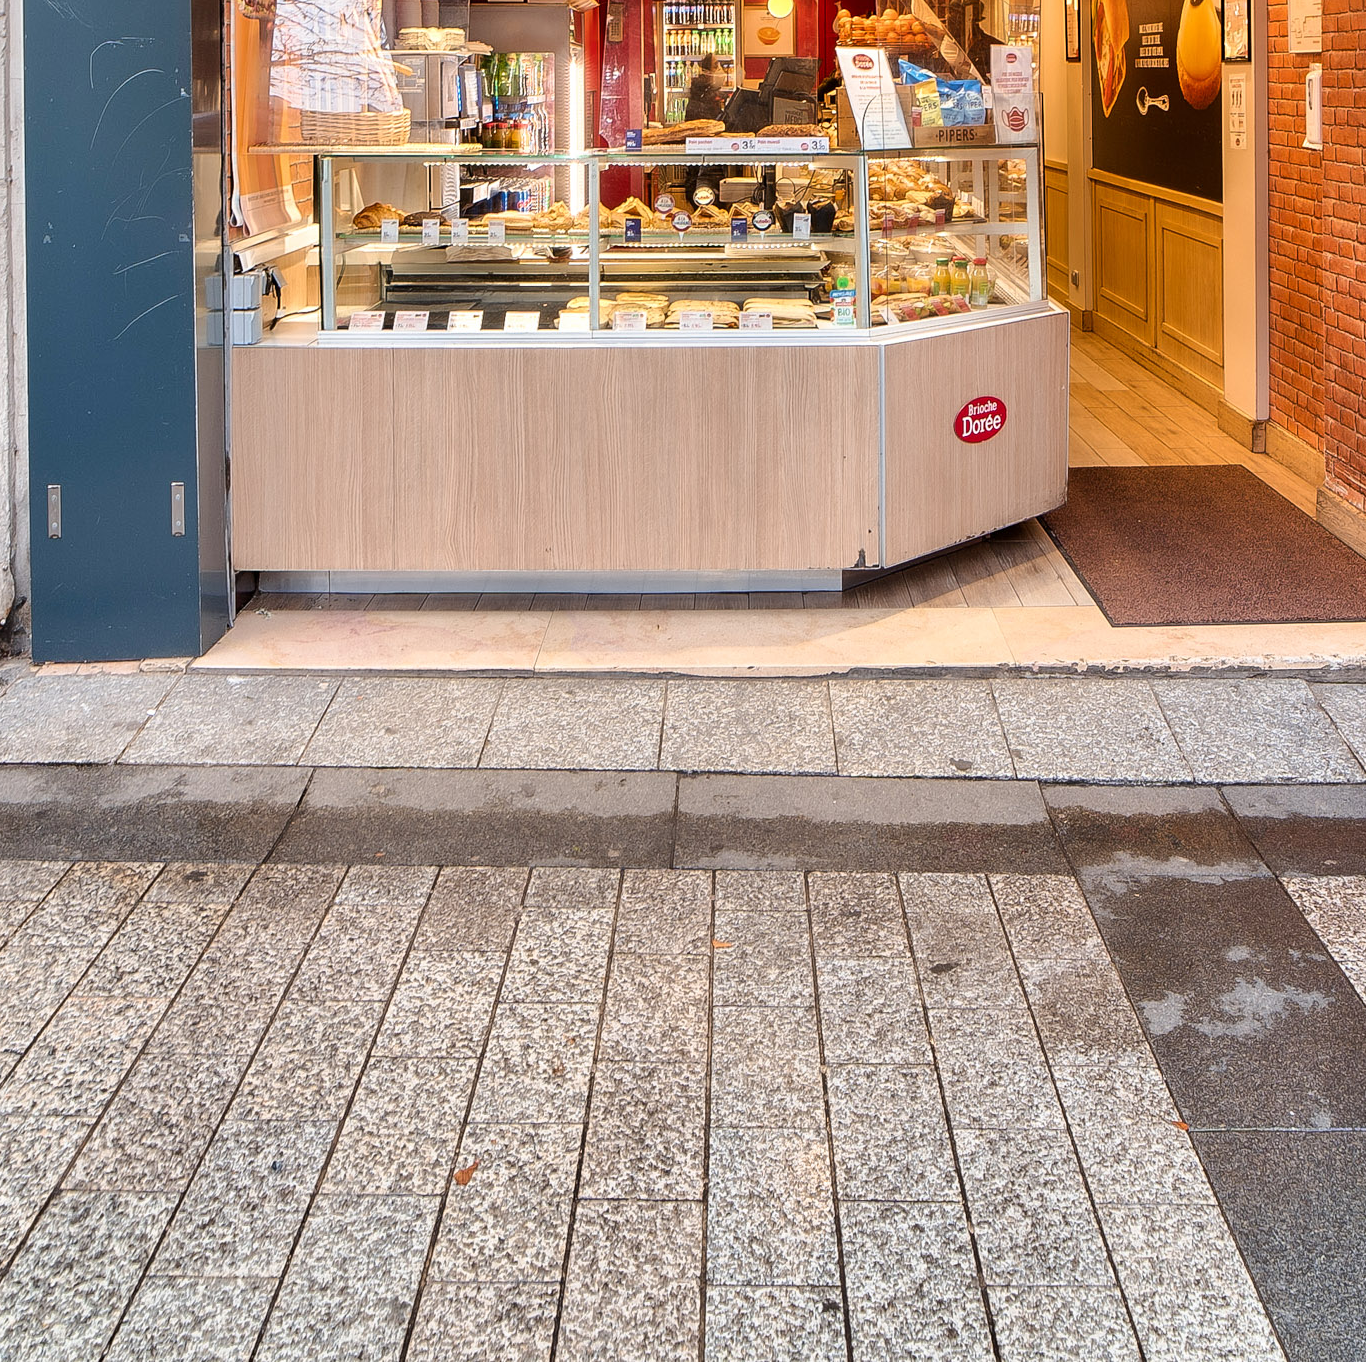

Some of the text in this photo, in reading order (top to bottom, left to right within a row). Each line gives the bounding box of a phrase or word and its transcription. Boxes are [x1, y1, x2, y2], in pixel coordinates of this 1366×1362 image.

[938, 128, 975, 143] PIPERS
[968, 400, 998, 417] Brioche
[962, 413, 1001, 437] Dorée
